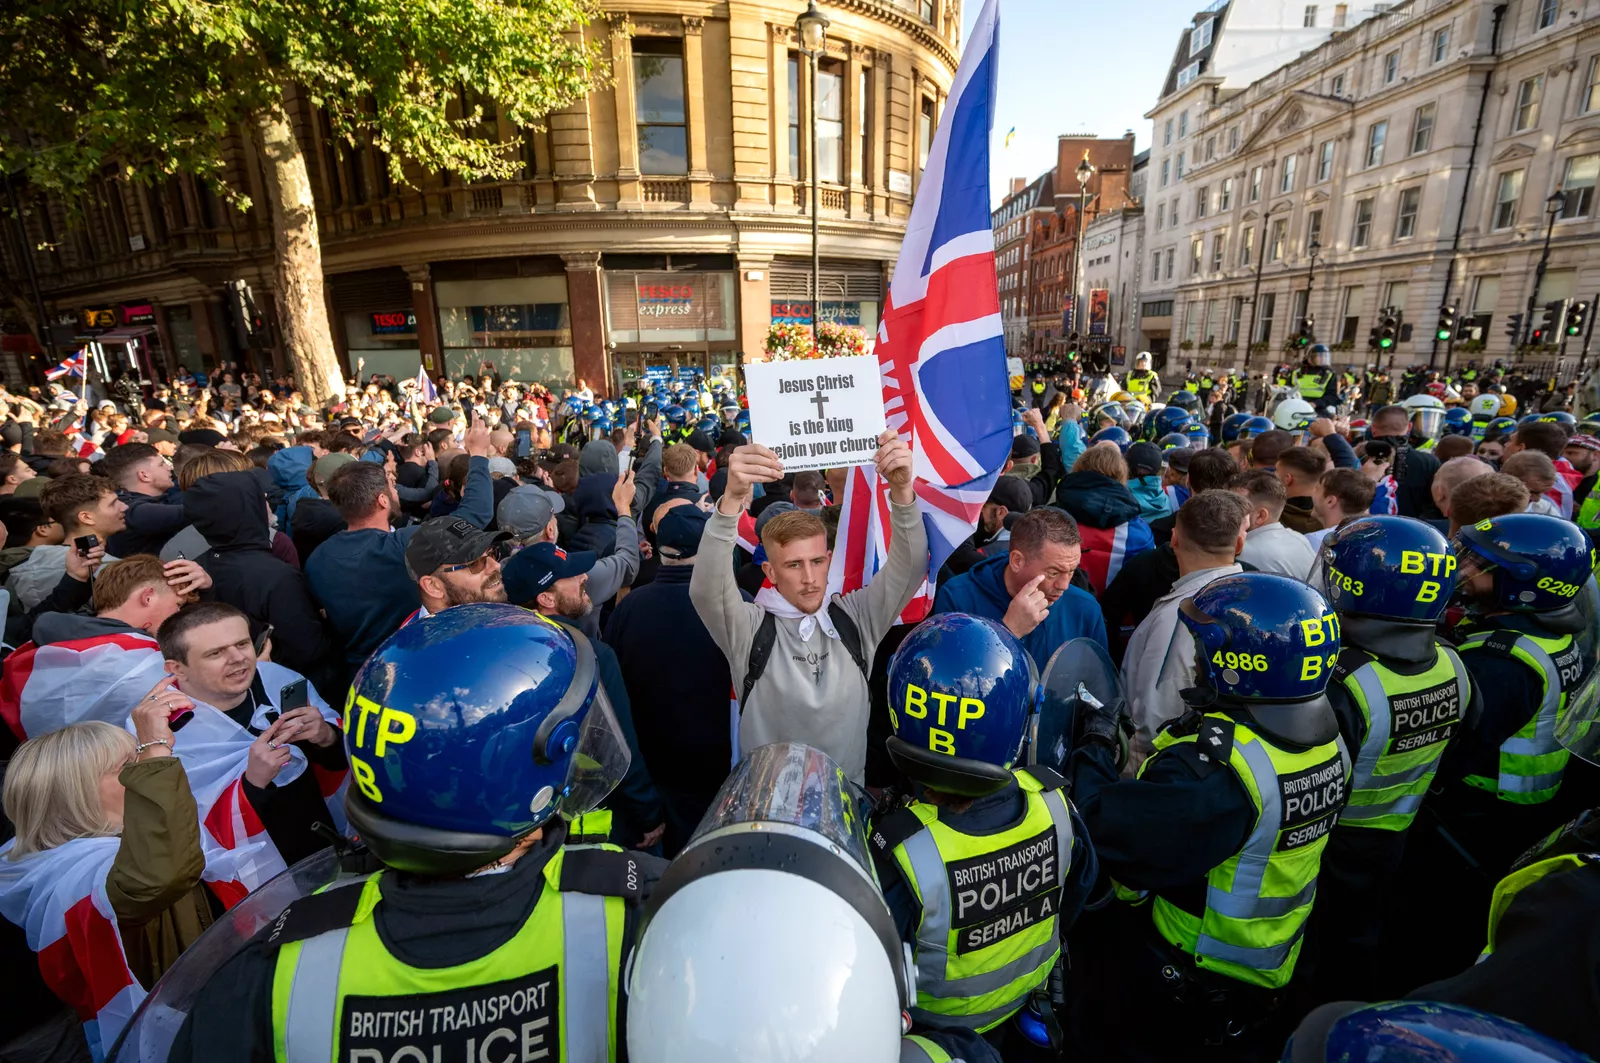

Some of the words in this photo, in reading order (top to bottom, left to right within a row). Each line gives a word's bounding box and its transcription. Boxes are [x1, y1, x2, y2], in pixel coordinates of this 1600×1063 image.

[638, 285, 693, 298] TESCO
[373, 313, 405, 327] TESCO
[639, 304, 690, 318] express
[771, 304, 812, 317] ESCO
[779, 378, 814, 394] Jesus
[816, 374, 854, 391] Christ
[789, 421, 801, 436] is
[803, 419, 824, 435] the
[826, 417, 854, 433] king
[809, 440, 837, 457] your
[1400, 550, 1457, 578] BTP
[1329, 566, 1364, 596] 7783
[1415, 580, 1441, 603] B
[1537, 577, 1580, 598] 6298
[1212, 650, 1268, 672] 4986
[1300, 656, 1323, 681] B
[905, 683, 986, 730] BTP
[1393, 696, 1421, 711] BRITISH
[1421, 683, 1457, 706] TRANSPORT
[1395, 697, 1458, 732] POLICE
[929, 727, 956, 756] B
[1396, 730, 1438, 751] SERIAL
[1441, 726, 1451, 738] A
[351, 754, 383, 803] B
[1284, 776, 1311, 795] BRITISH
[1311, 760, 1342, 787] TRANSPORT
[1286, 777, 1344, 821] POLICE
[873, 832, 886, 850] 5930
[1286, 819, 1328, 847] SERIAL
[627, 860, 637, 890] 0070
[954, 861, 996, 887] BRITISH
[997, 836, 1053, 874] TRANSPORT
[958, 855, 1055, 919] POLICE
[268, 908, 291, 943] 0070
[968, 907, 1033, 947] SERIAL
[1040, 896, 1052, 917] A
[350, 1008, 424, 1038] BRITISH
[429, 981, 550, 1034] TRANSPORT
